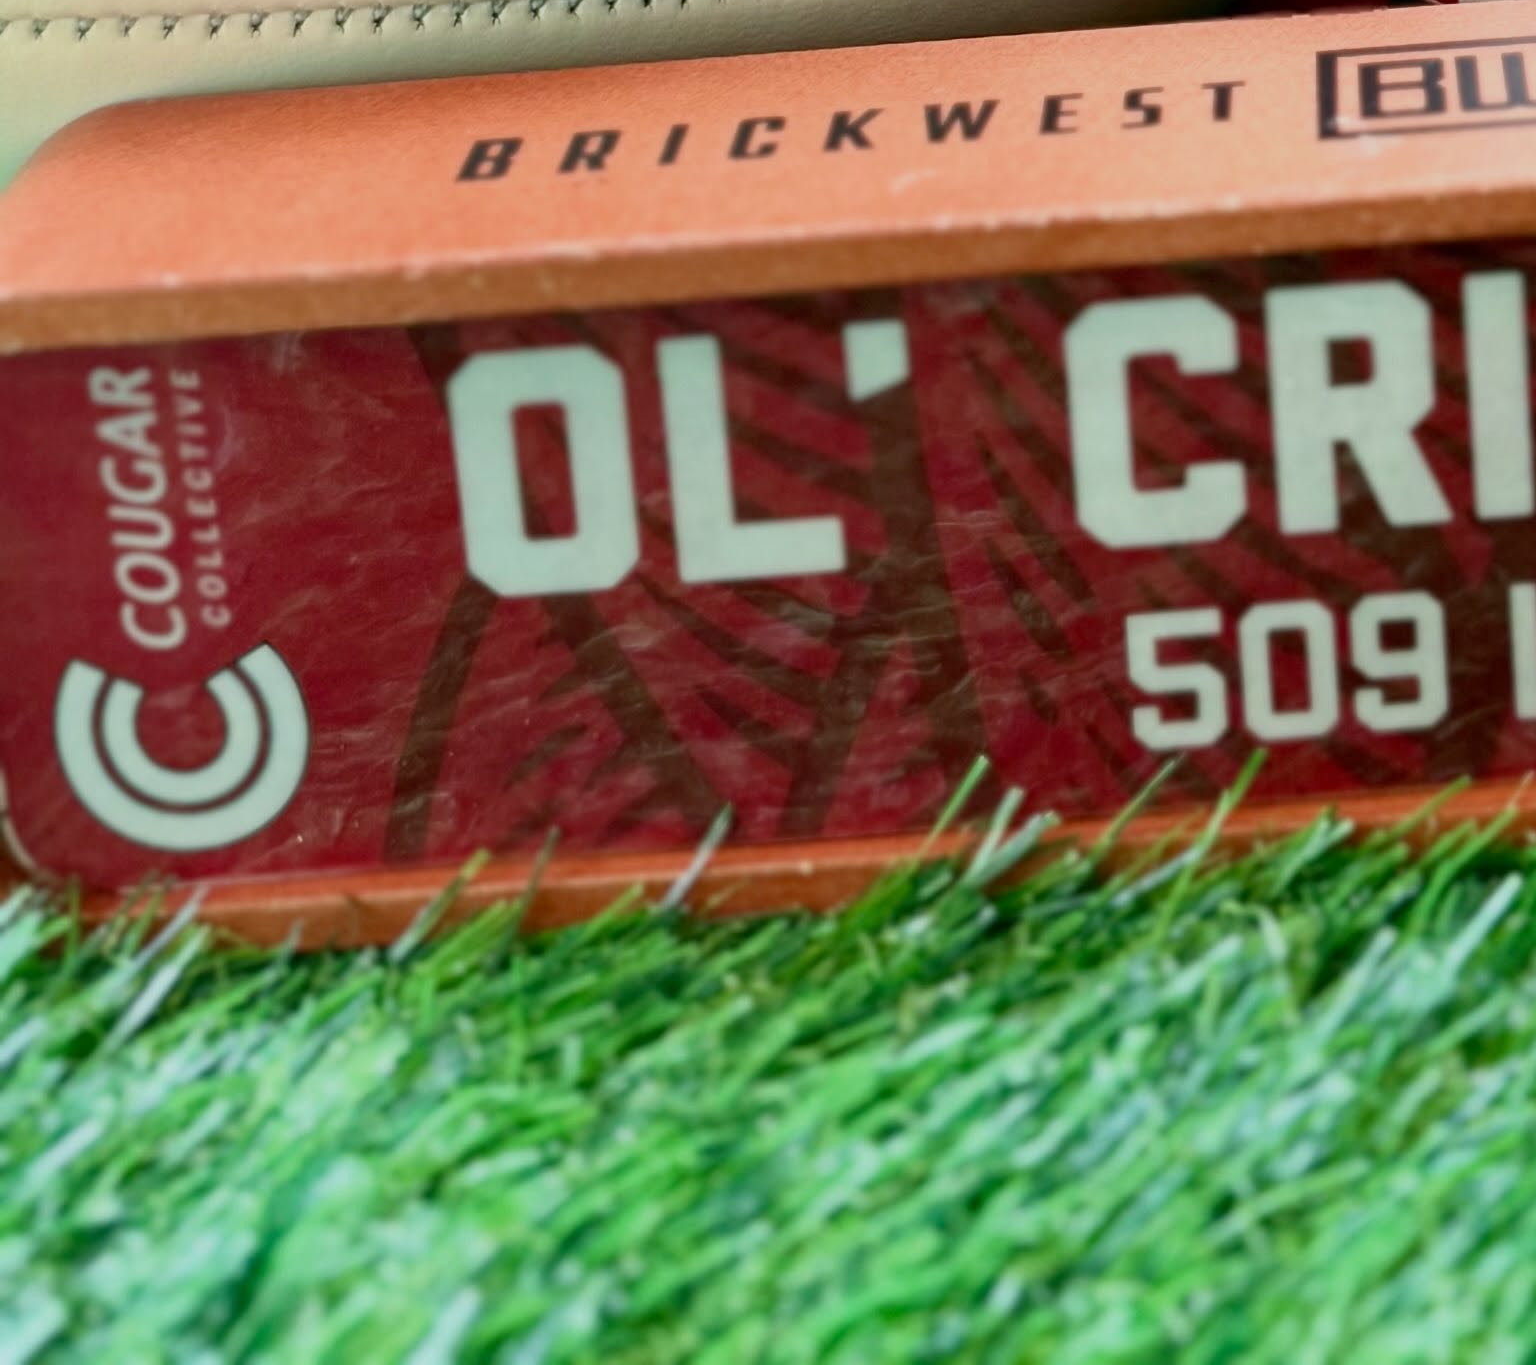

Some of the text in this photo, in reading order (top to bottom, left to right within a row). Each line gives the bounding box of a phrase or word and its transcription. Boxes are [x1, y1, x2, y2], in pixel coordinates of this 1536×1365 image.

[456, 80, 1246, 182] BRICKWEST
[88, 366, 187, 651] COUGAR
[170, 369, 232, 628] COLLECTIVE
[446, 318, 910, 598] OL'
[1125, 590, 1448, 750] 509
